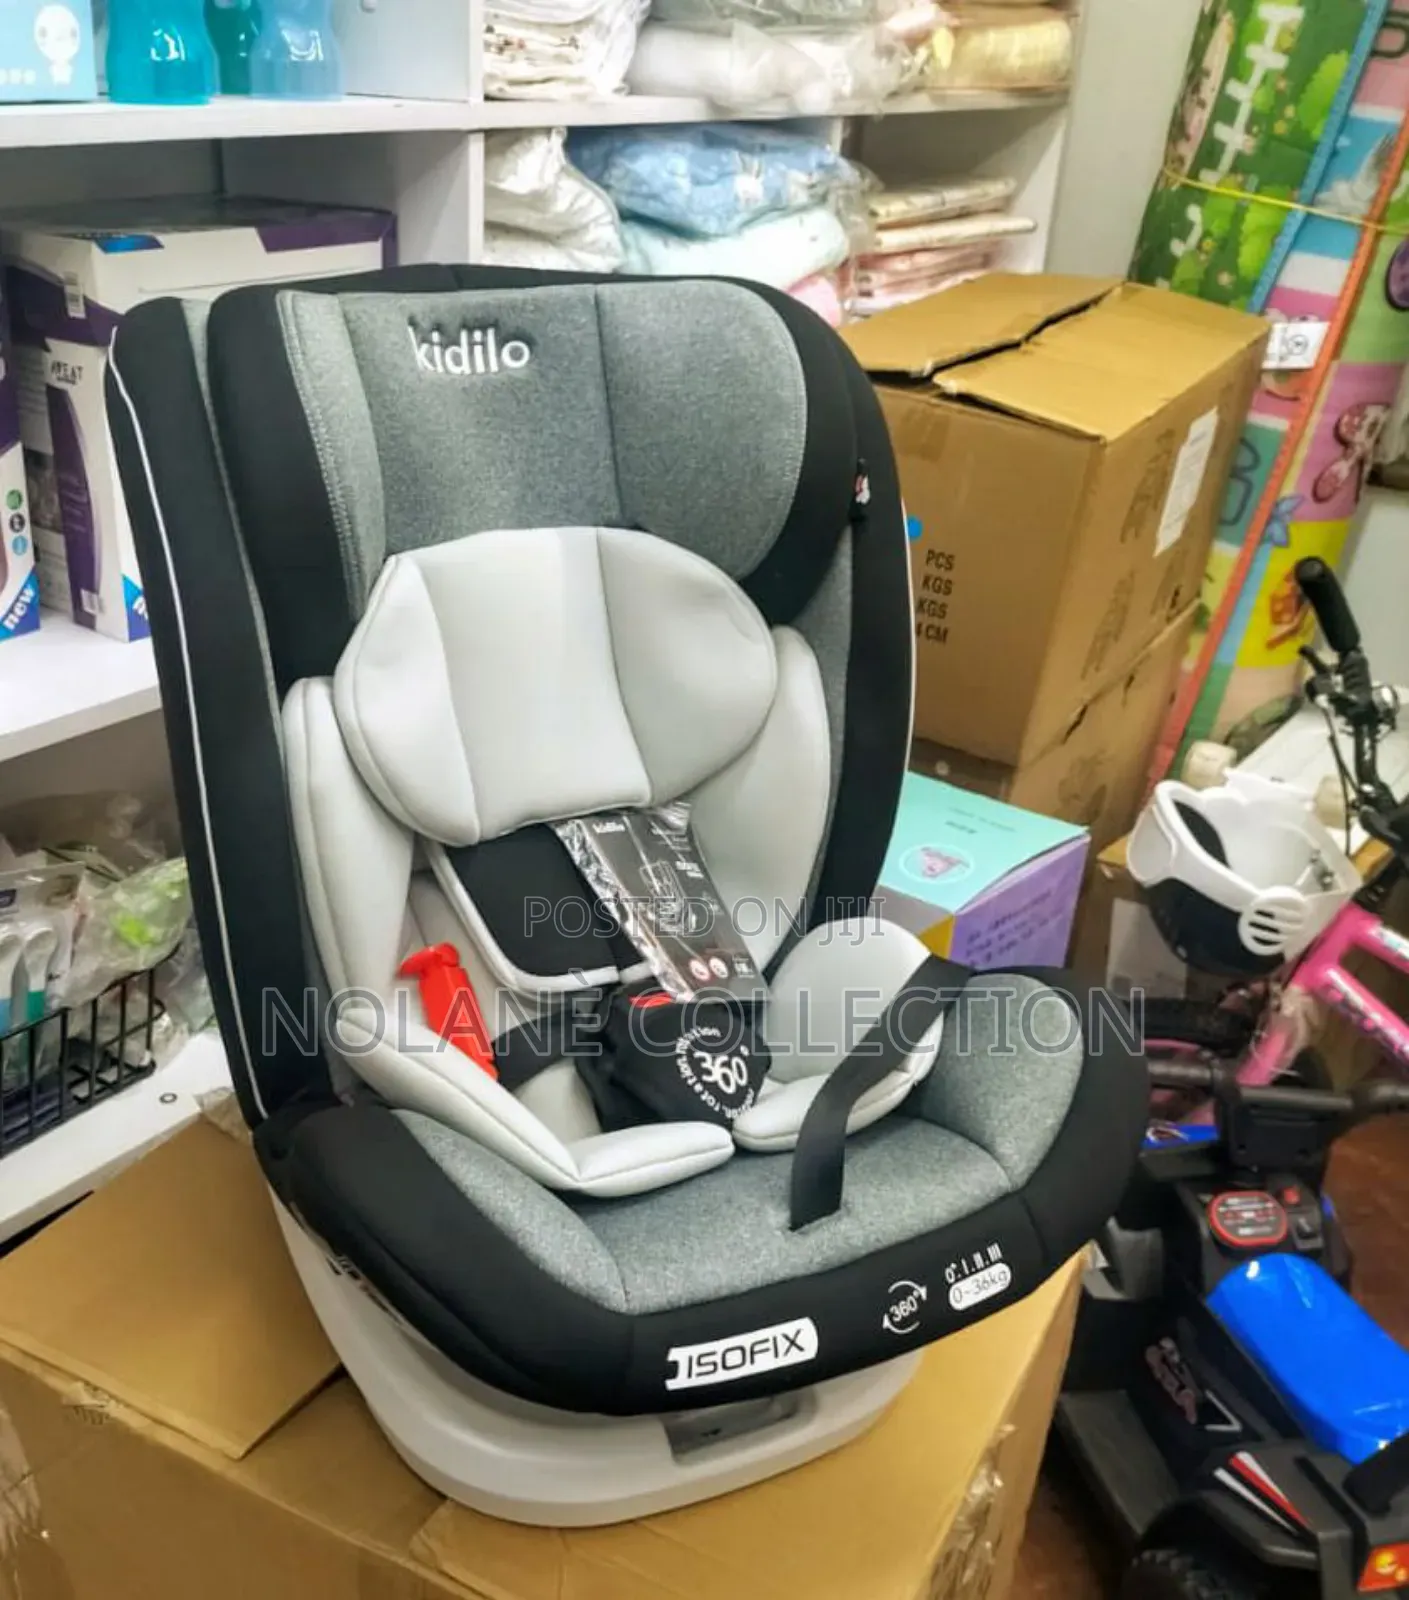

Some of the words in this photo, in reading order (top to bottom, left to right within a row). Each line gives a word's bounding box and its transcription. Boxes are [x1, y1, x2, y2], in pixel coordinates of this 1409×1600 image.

[407, 325, 530, 375] kidilo
[925, 549, 955, 572] PCS
[922, 575, 953, 596] KGS
[687, 1328, 806, 1380] ISOFIX
